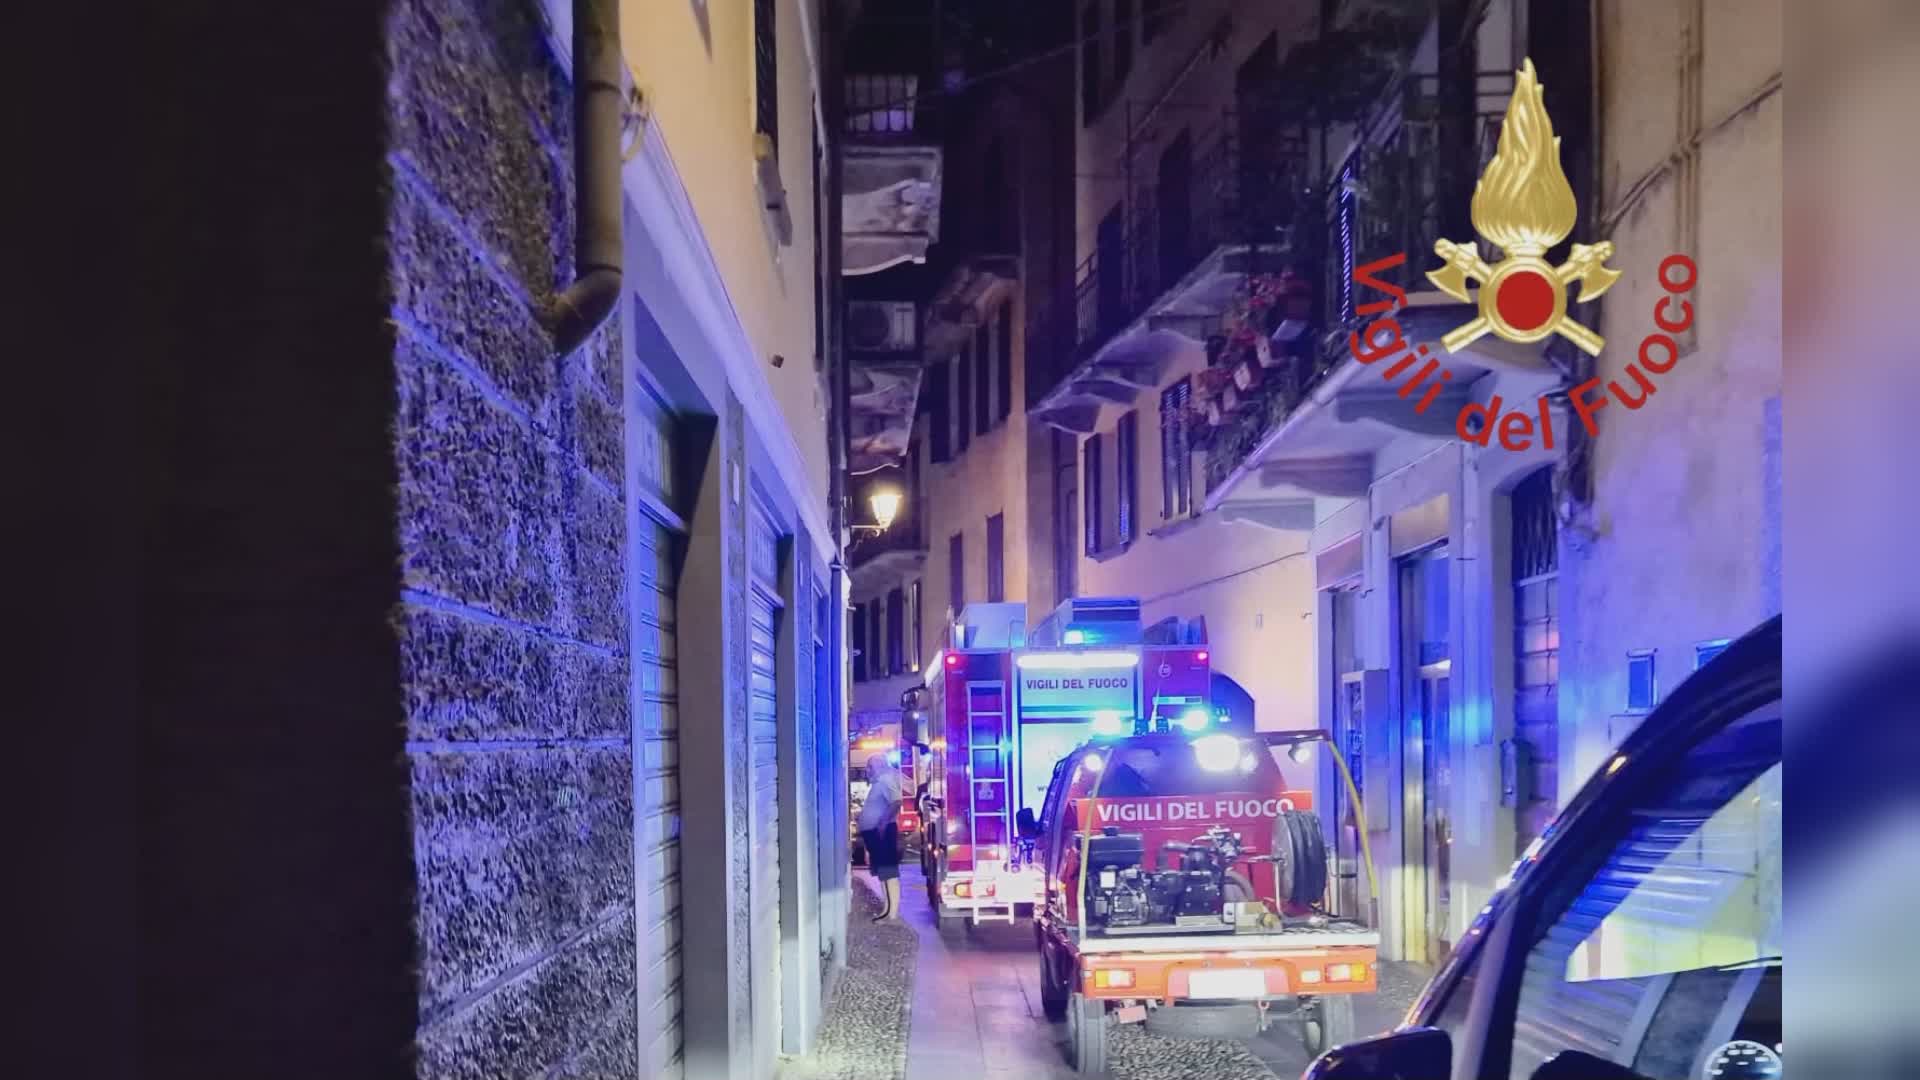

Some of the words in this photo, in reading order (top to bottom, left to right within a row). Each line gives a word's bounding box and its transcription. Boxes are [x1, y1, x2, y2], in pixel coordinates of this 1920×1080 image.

[1026, 679, 1058, 690] VIGILI
[1062, 678, 1084, 689] DEL
[1088, 678, 1128, 689] FUOCO
[1097, 803, 1163, 822] VIGILI
[1167, 801, 1211, 820] DEL
[1215, 798, 1295, 819] FUOCO
